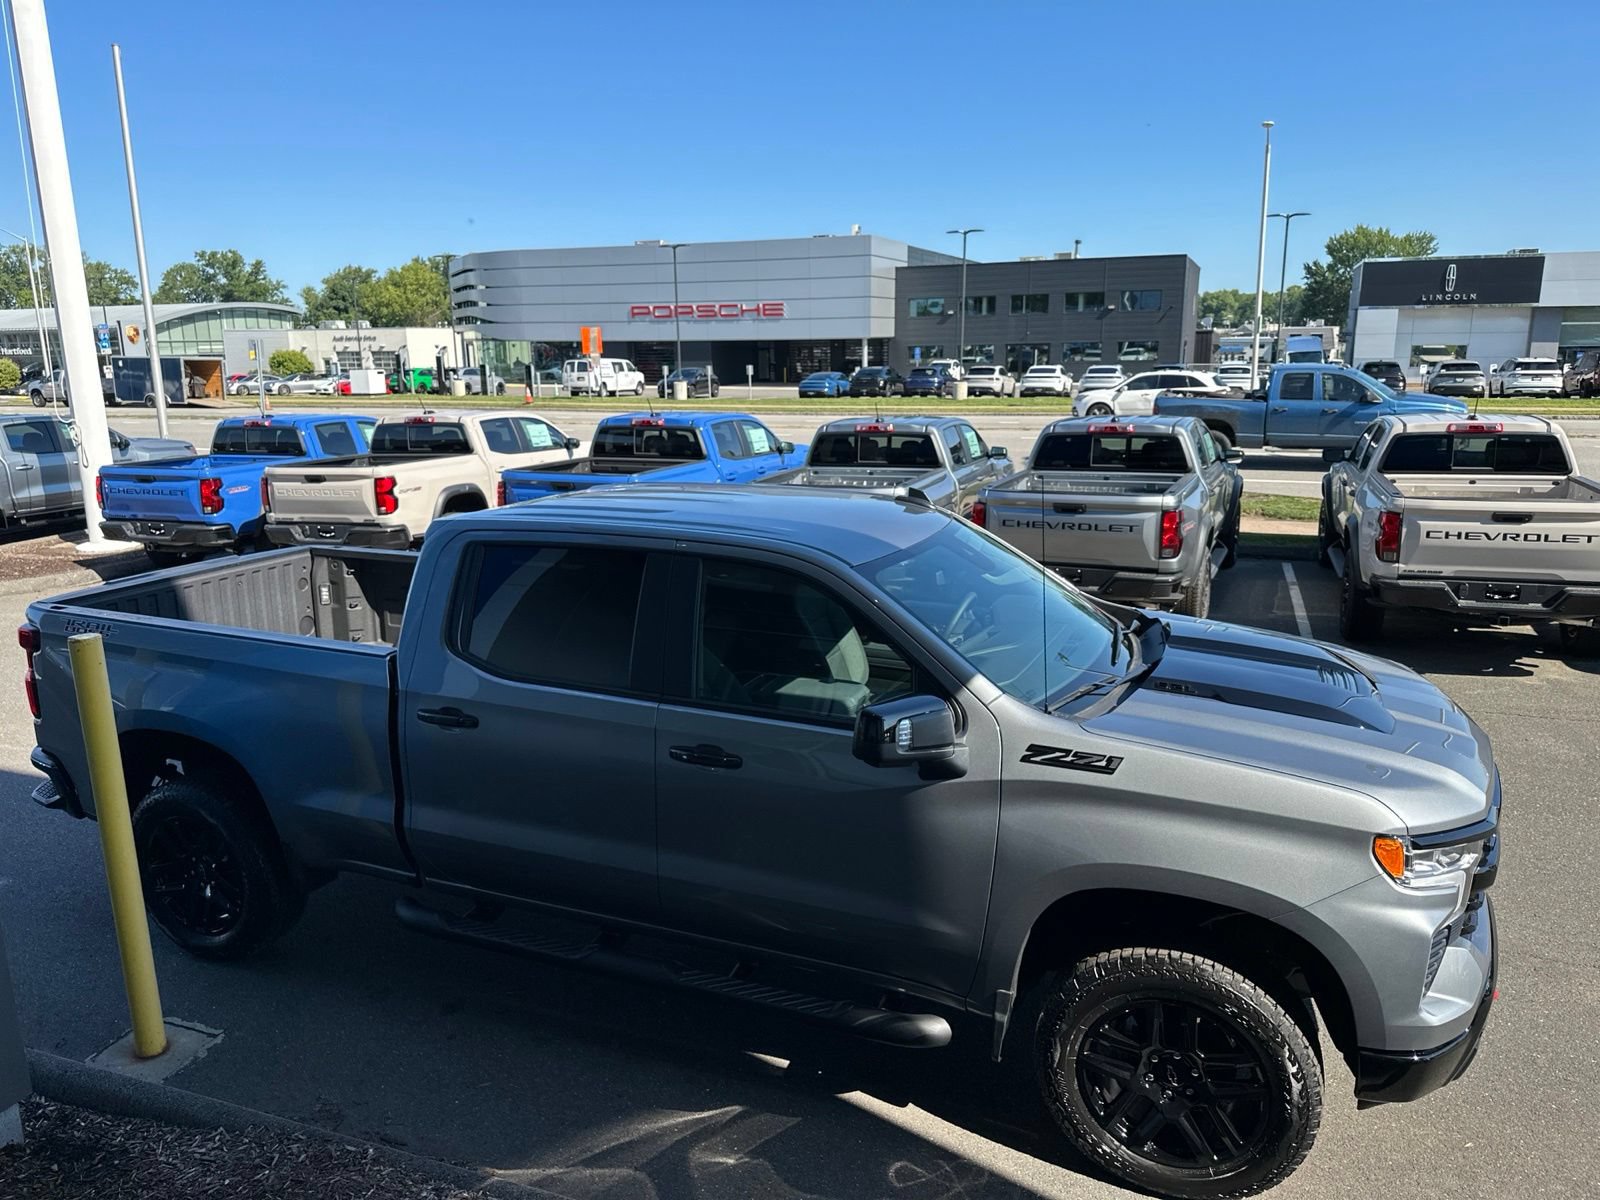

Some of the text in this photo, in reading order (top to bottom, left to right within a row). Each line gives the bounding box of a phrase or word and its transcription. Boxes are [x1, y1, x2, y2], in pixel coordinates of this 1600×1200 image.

[1421, 293, 1477, 301] LINCOLN
[630, 302, 785, 319] PORSCHE
[1, 347, 33, 355] Hartford
[109, 487, 186, 497] CHEVROLET
[275, 488, 361, 497] CHEVROLET
[1002, 519, 1140, 533] CHEVROLET
[1425, 530, 1600, 544] CHEVROLET
[1019, 743, 1125, 775] Z71
